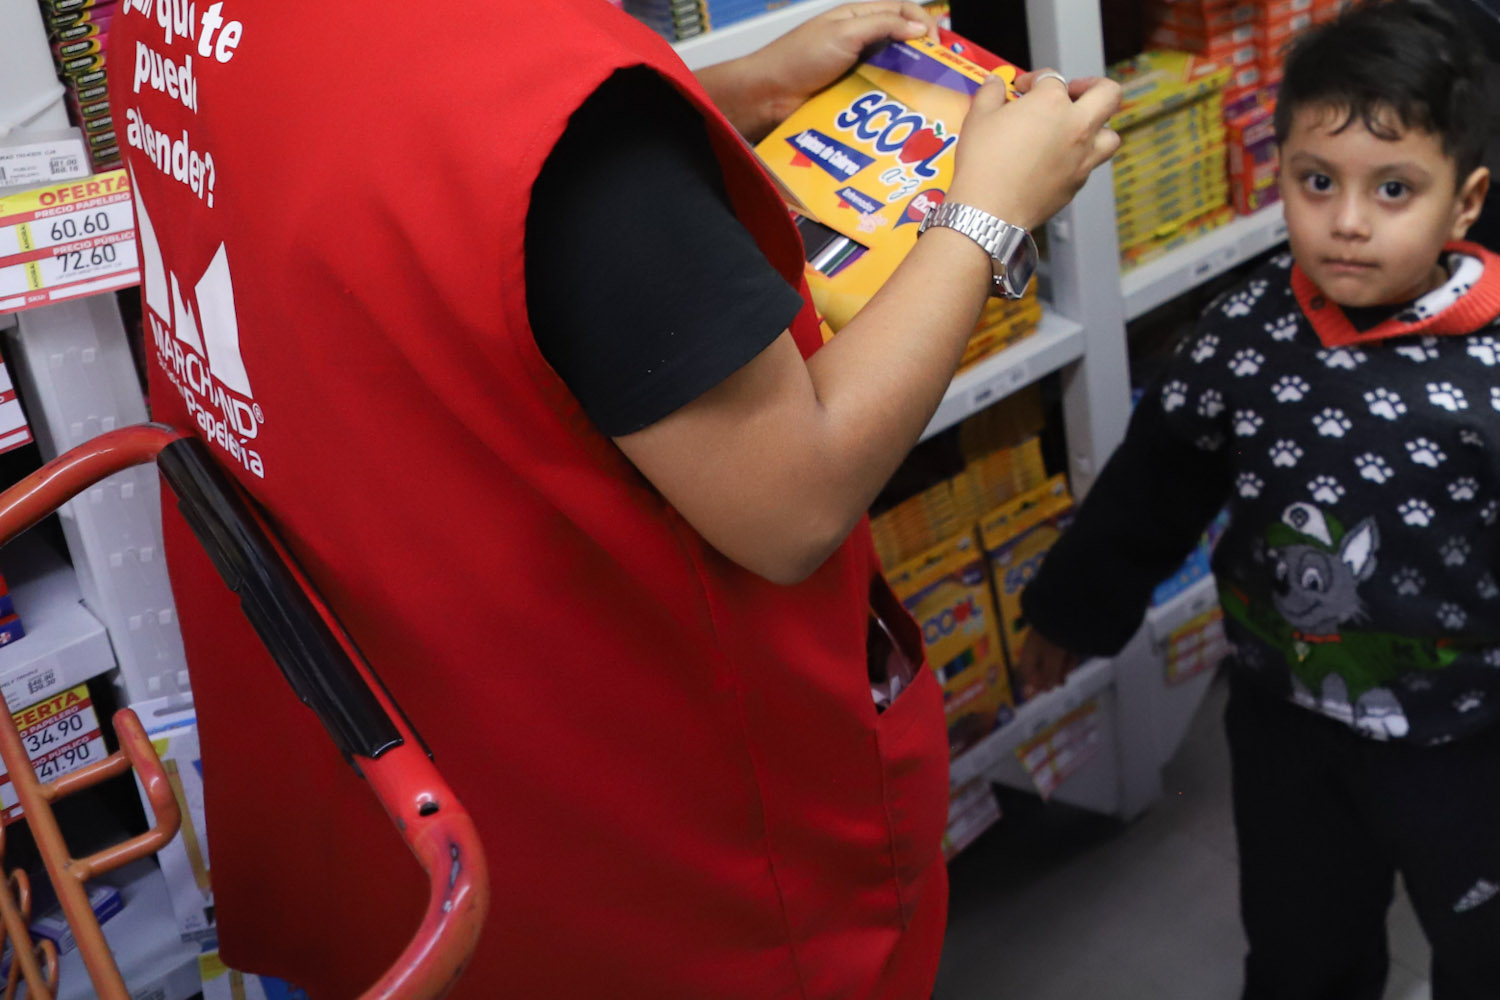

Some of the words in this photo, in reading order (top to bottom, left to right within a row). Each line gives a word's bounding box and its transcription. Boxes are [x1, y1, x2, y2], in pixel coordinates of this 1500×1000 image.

[198, 1, 243, 64] te
[126, 106, 216, 209] atender?
[34, 202, 74, 220] PRECIO
[76, 191, 131, 210] PAPELERO
[39, 175, 130, 206] OFERTA
[50, 211, 110, 241] 60.60
[53, 240, 92, 256] PRECIO
[57, 243, 117, 273] 72.60
[27, 714, 83, 752] 34.90
[29, 706, 79, 733] PAPELERO
[40, 742, 90, 778] 41.90
